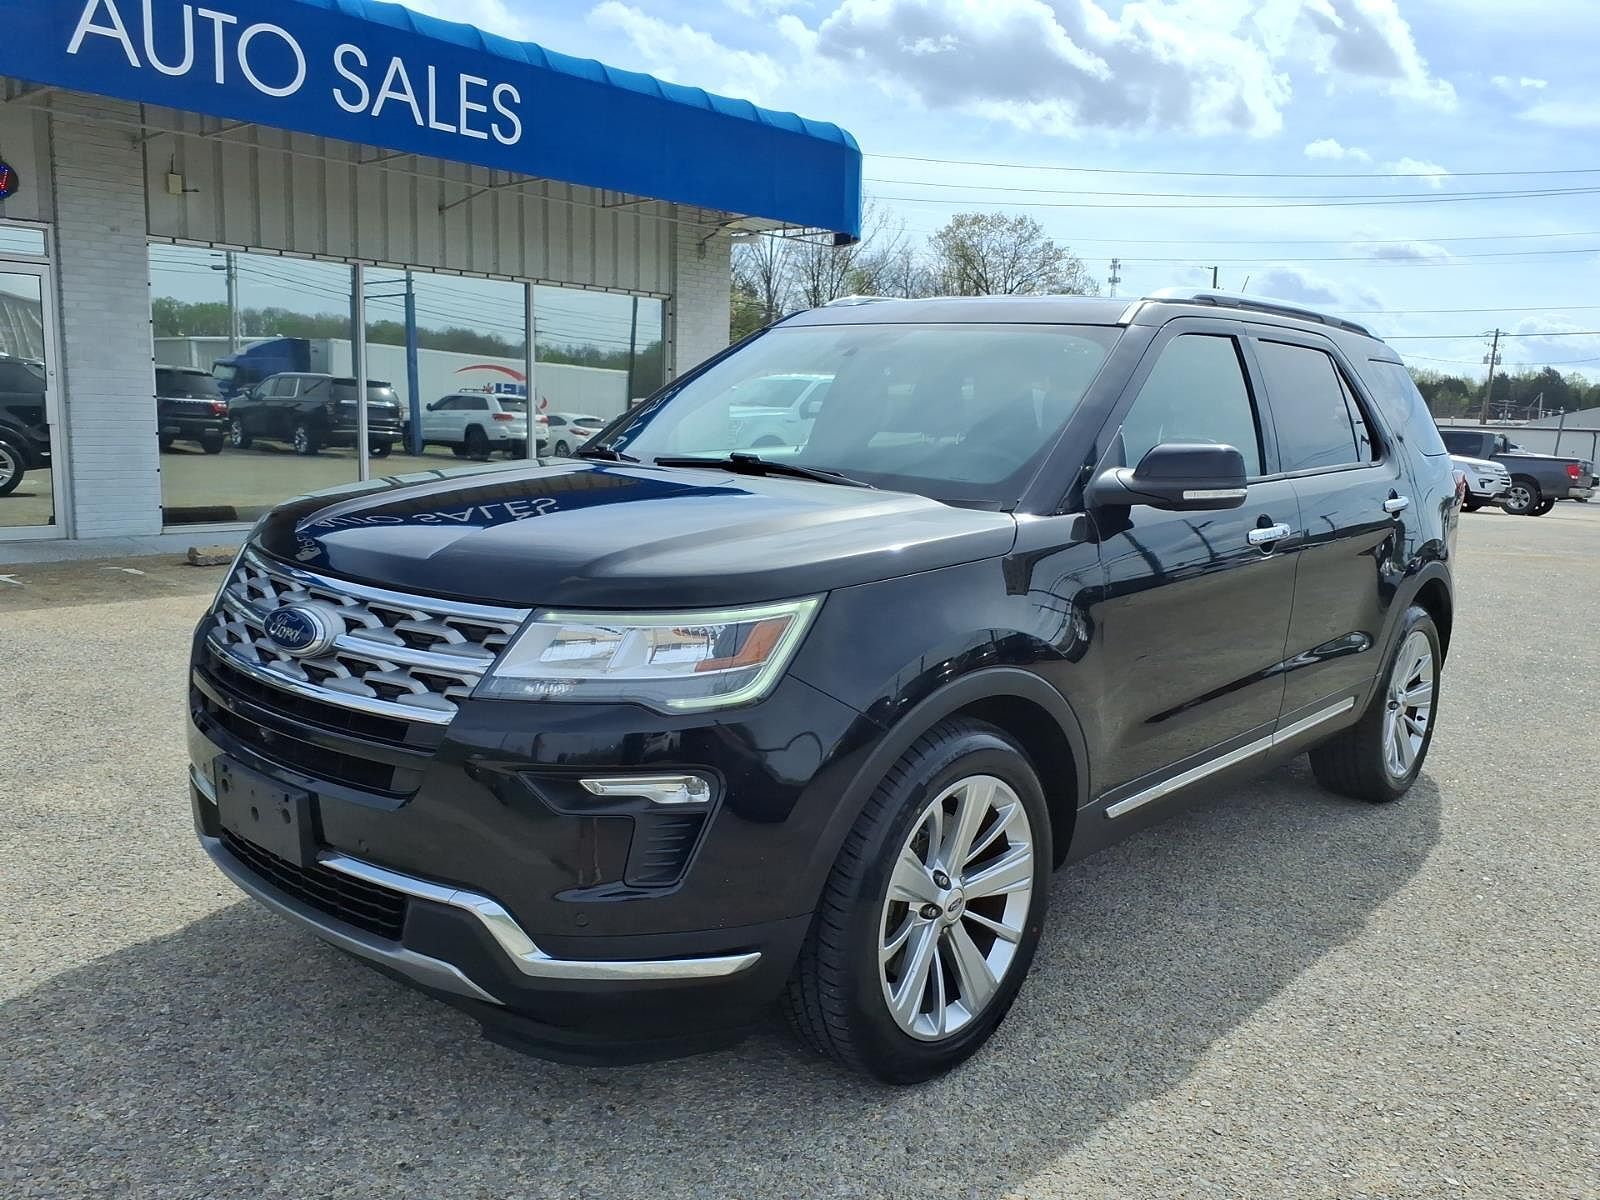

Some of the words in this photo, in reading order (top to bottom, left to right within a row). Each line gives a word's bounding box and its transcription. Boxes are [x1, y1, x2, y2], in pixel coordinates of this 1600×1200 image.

[66, 0, 307, 97] AUTO
[332, 43, 522, 146] SALES
[268, 612, 305, 643] Ford
